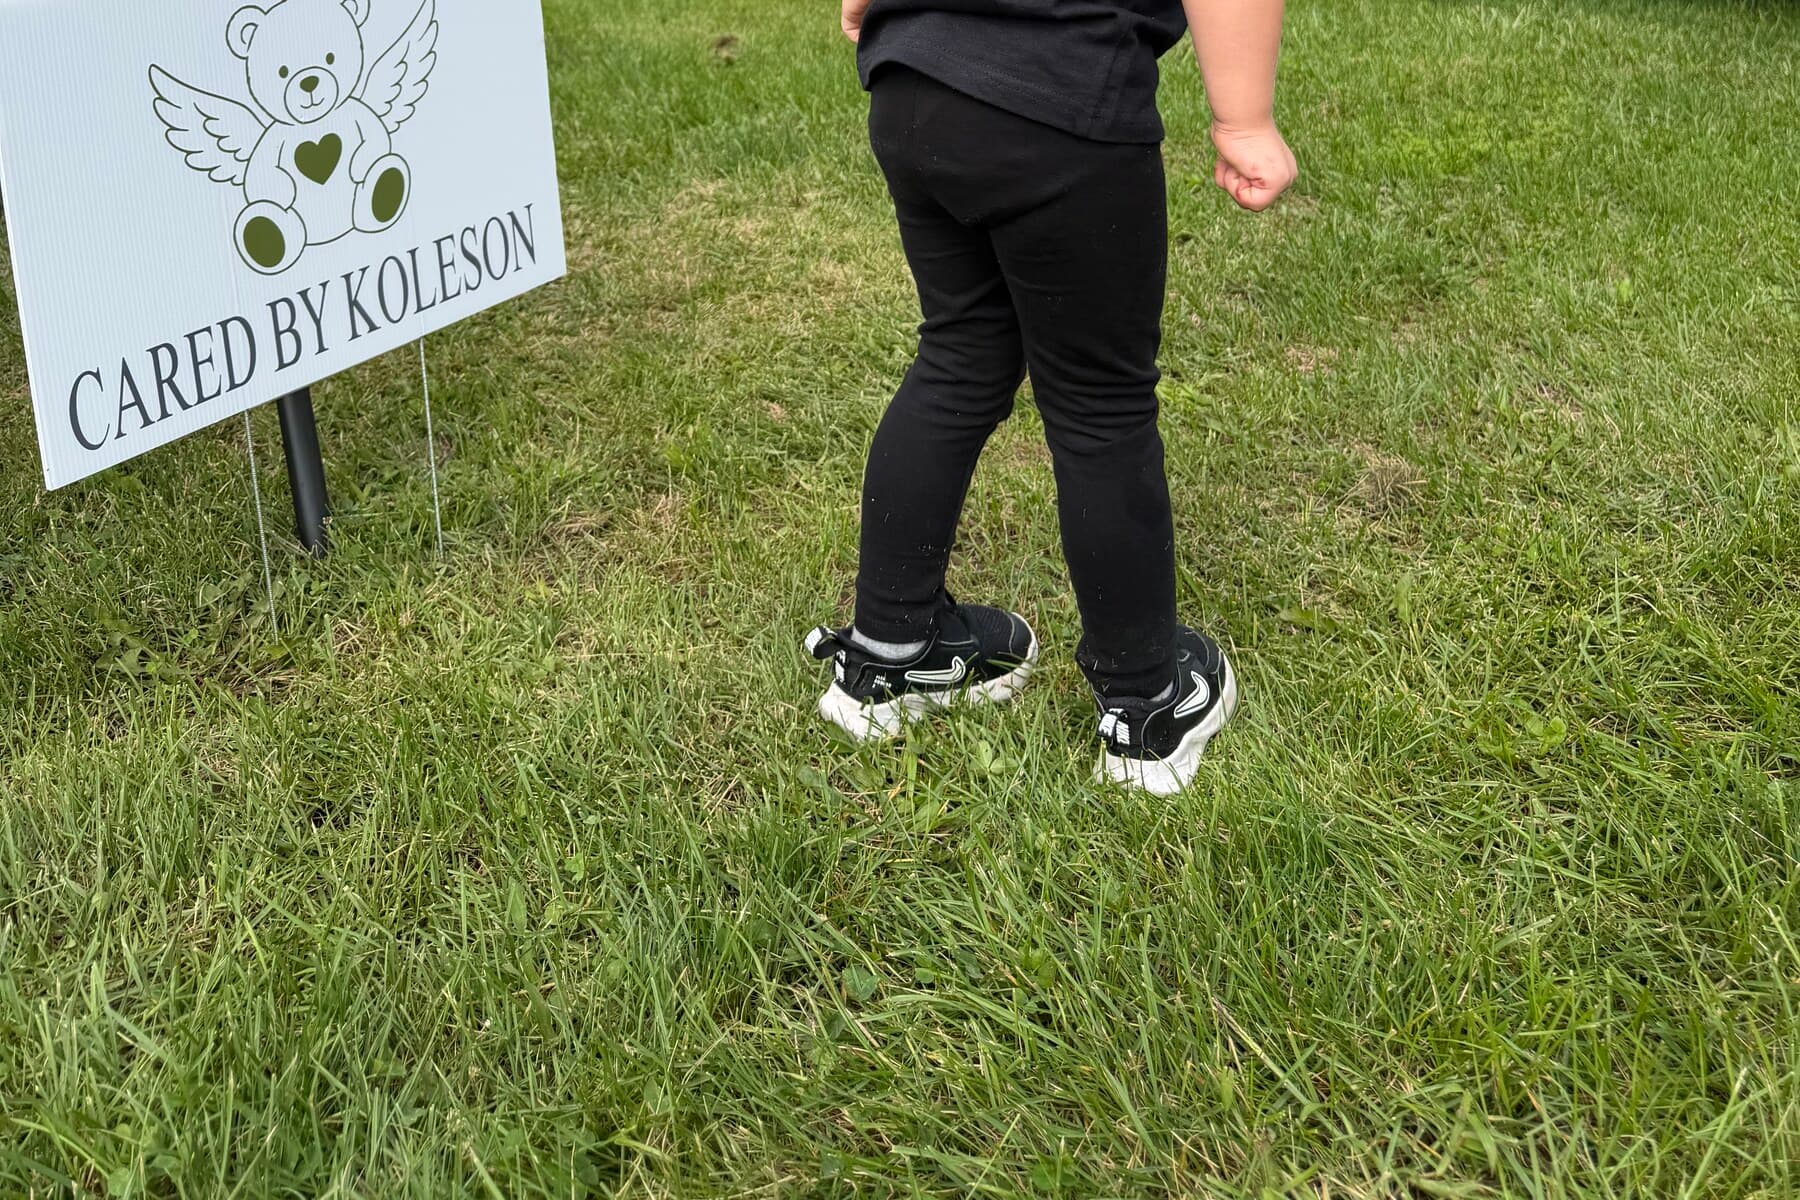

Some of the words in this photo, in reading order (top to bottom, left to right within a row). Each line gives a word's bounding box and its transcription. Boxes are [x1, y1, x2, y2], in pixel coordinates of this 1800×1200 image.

[69, 315, 258, 451] CARED
[267, 281, 331, 373] BY
[340, 203, 538, 342] KOLESON
